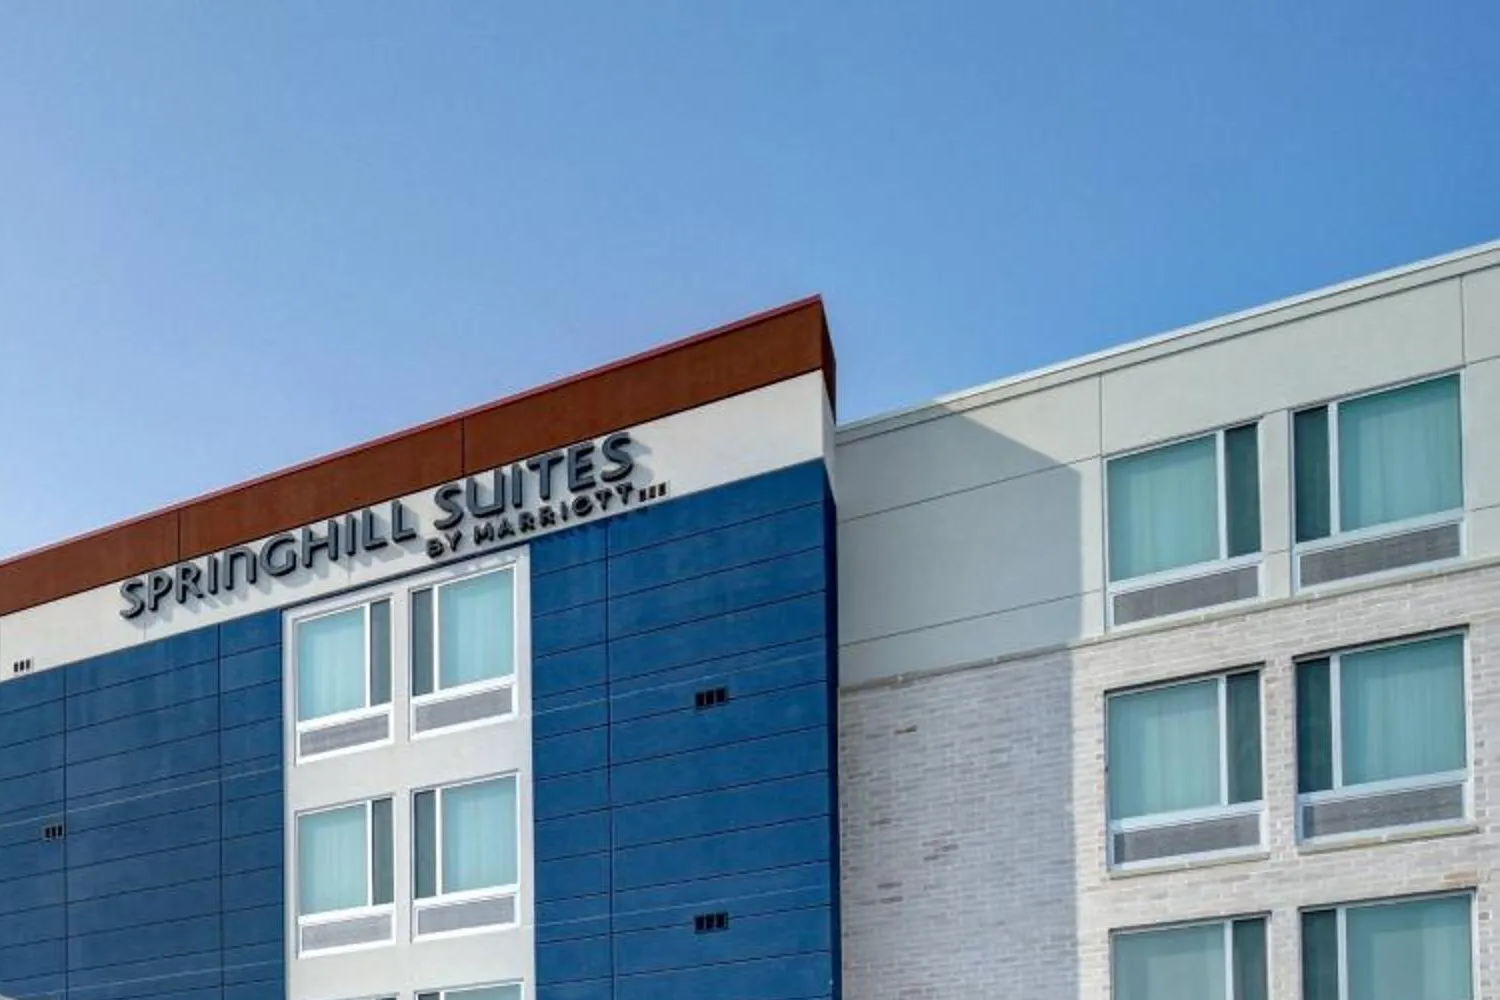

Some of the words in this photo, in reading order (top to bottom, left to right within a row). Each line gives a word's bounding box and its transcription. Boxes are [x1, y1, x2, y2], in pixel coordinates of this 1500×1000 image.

[119, 499, 417, 619] SPRINGHILL
[433, 431, 635, 531] SUITES
[426, 530, 463, 559] BY
[473, 481, 634, 546] MARRIOTT
